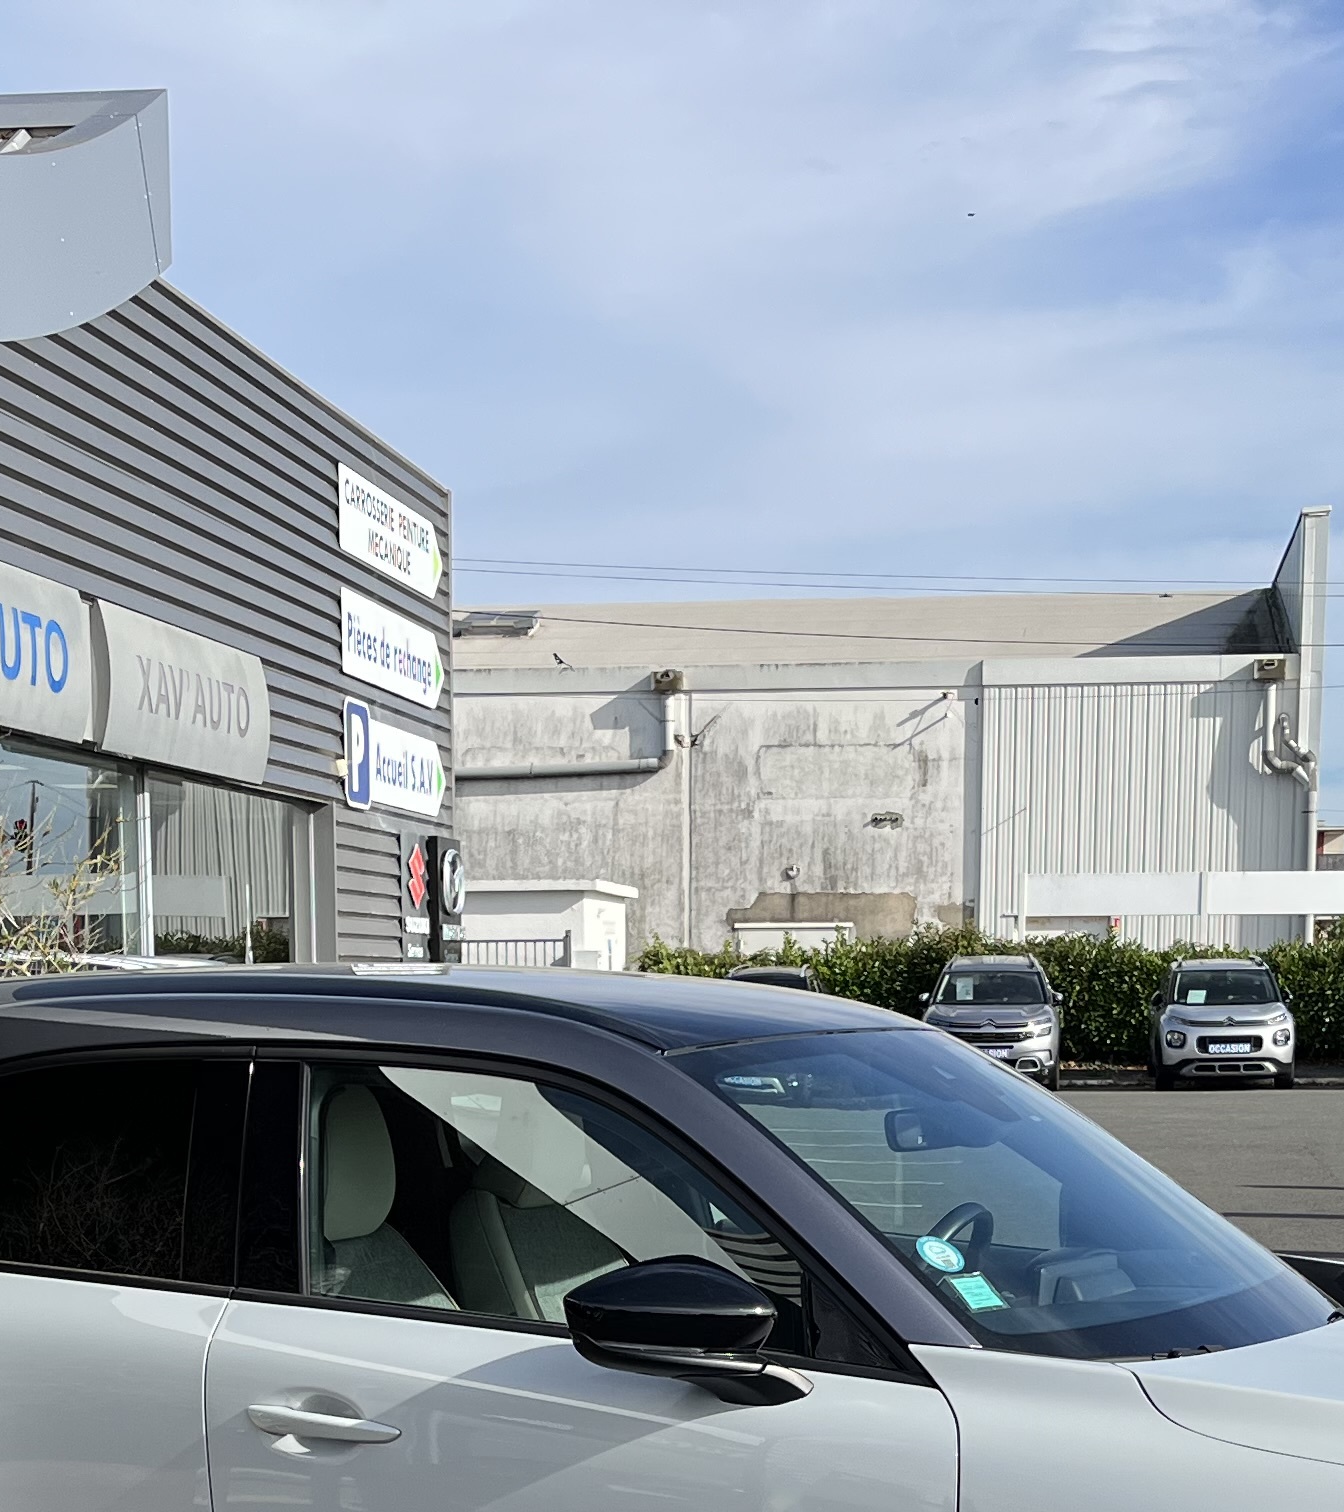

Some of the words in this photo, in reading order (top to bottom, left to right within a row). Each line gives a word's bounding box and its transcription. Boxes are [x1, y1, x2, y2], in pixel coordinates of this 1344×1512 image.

[344, 477, 395, 532] CARROSSERIE
[398, 512, 430, 554] PEINTURE
[367, 528, 411, 575] MECANIQUE
[380, 625, 391, 670] de
[393, 638, 432, 695] rechange
[136, 655, 251, 738] XAV'AUTO
[351, 713, 365, 793] P
[375, 743, 408, 790] Accueil
[1208, 1043, 1251, 1054] OCCASION
